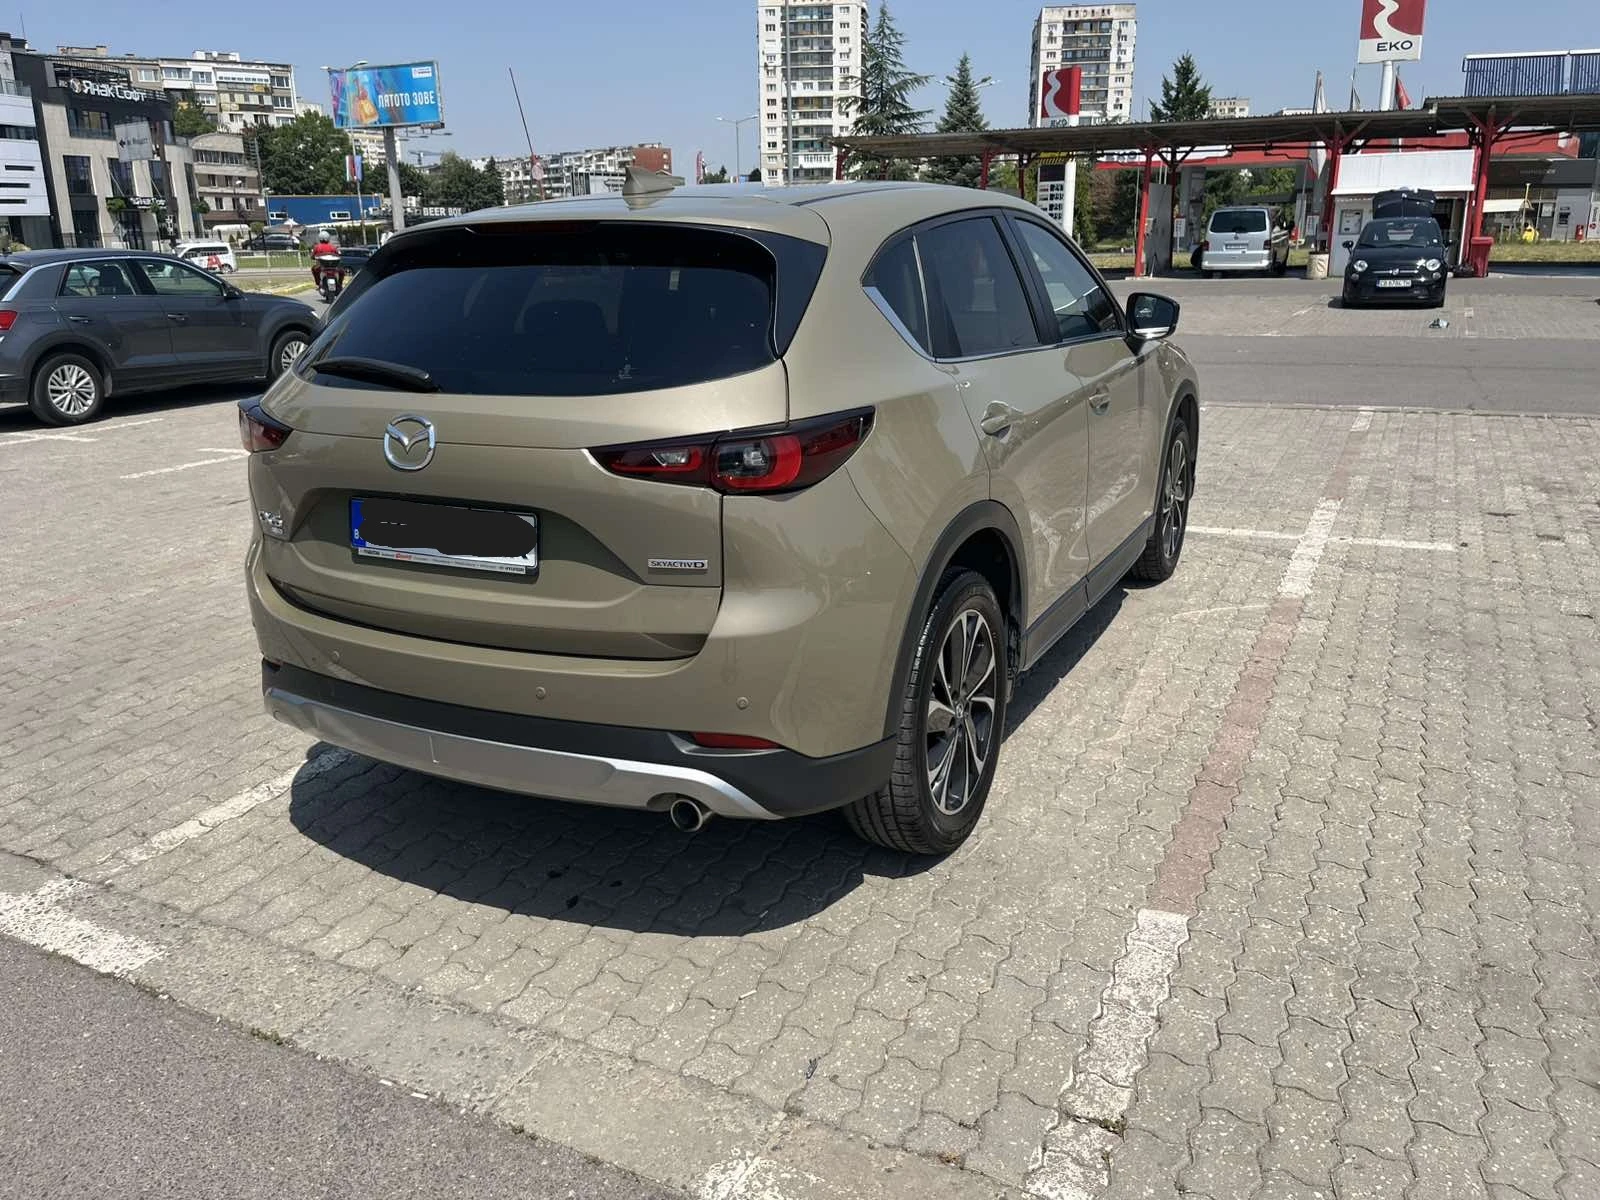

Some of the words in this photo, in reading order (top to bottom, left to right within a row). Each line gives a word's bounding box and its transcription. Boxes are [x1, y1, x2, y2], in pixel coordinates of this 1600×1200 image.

[1376, 40, 1413, 52] EKO
[378, 93, 410, 109] ЛЯТОТО
[412, 90, 436, 105] ЗОВЕ
[422, 207, 446, 217] BEER
